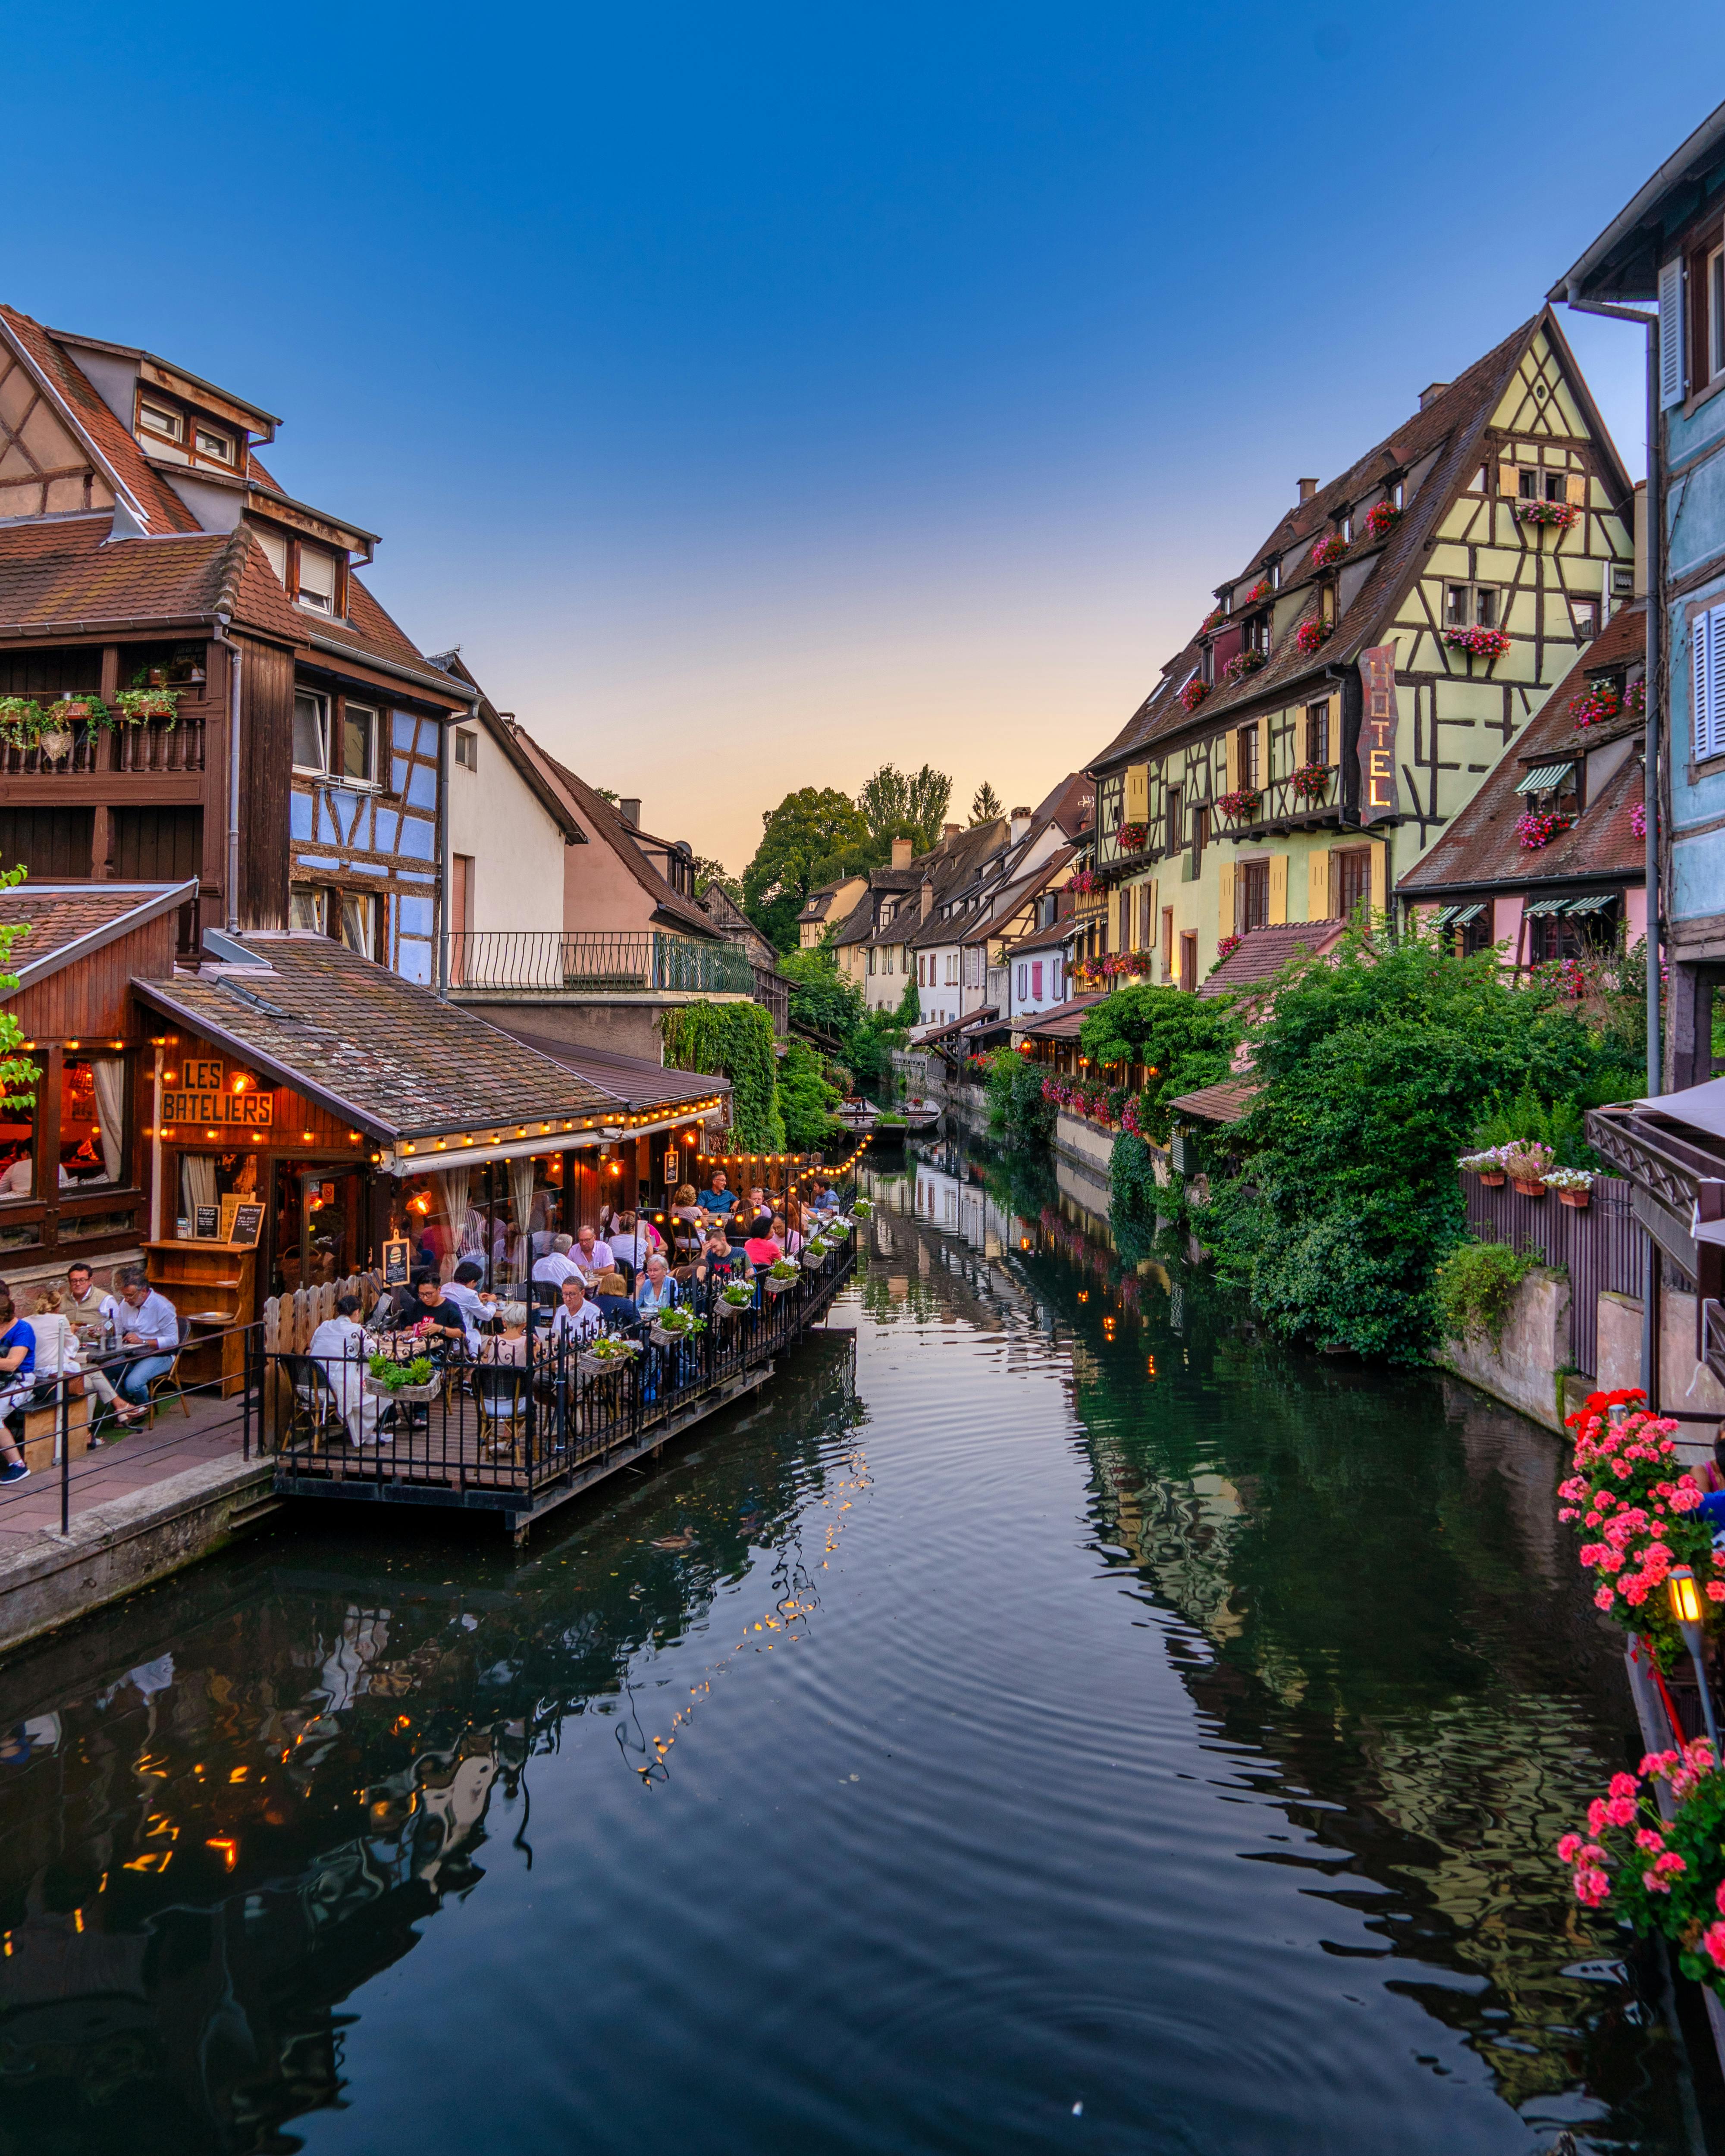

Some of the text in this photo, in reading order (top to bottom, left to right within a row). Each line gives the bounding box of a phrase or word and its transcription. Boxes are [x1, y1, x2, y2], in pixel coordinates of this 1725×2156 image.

[1370, 662, 1391, 806] HOTEL
[185, 1062, 220, 1089] LES
[164, 1094, 270, 1122] BATELIERS
